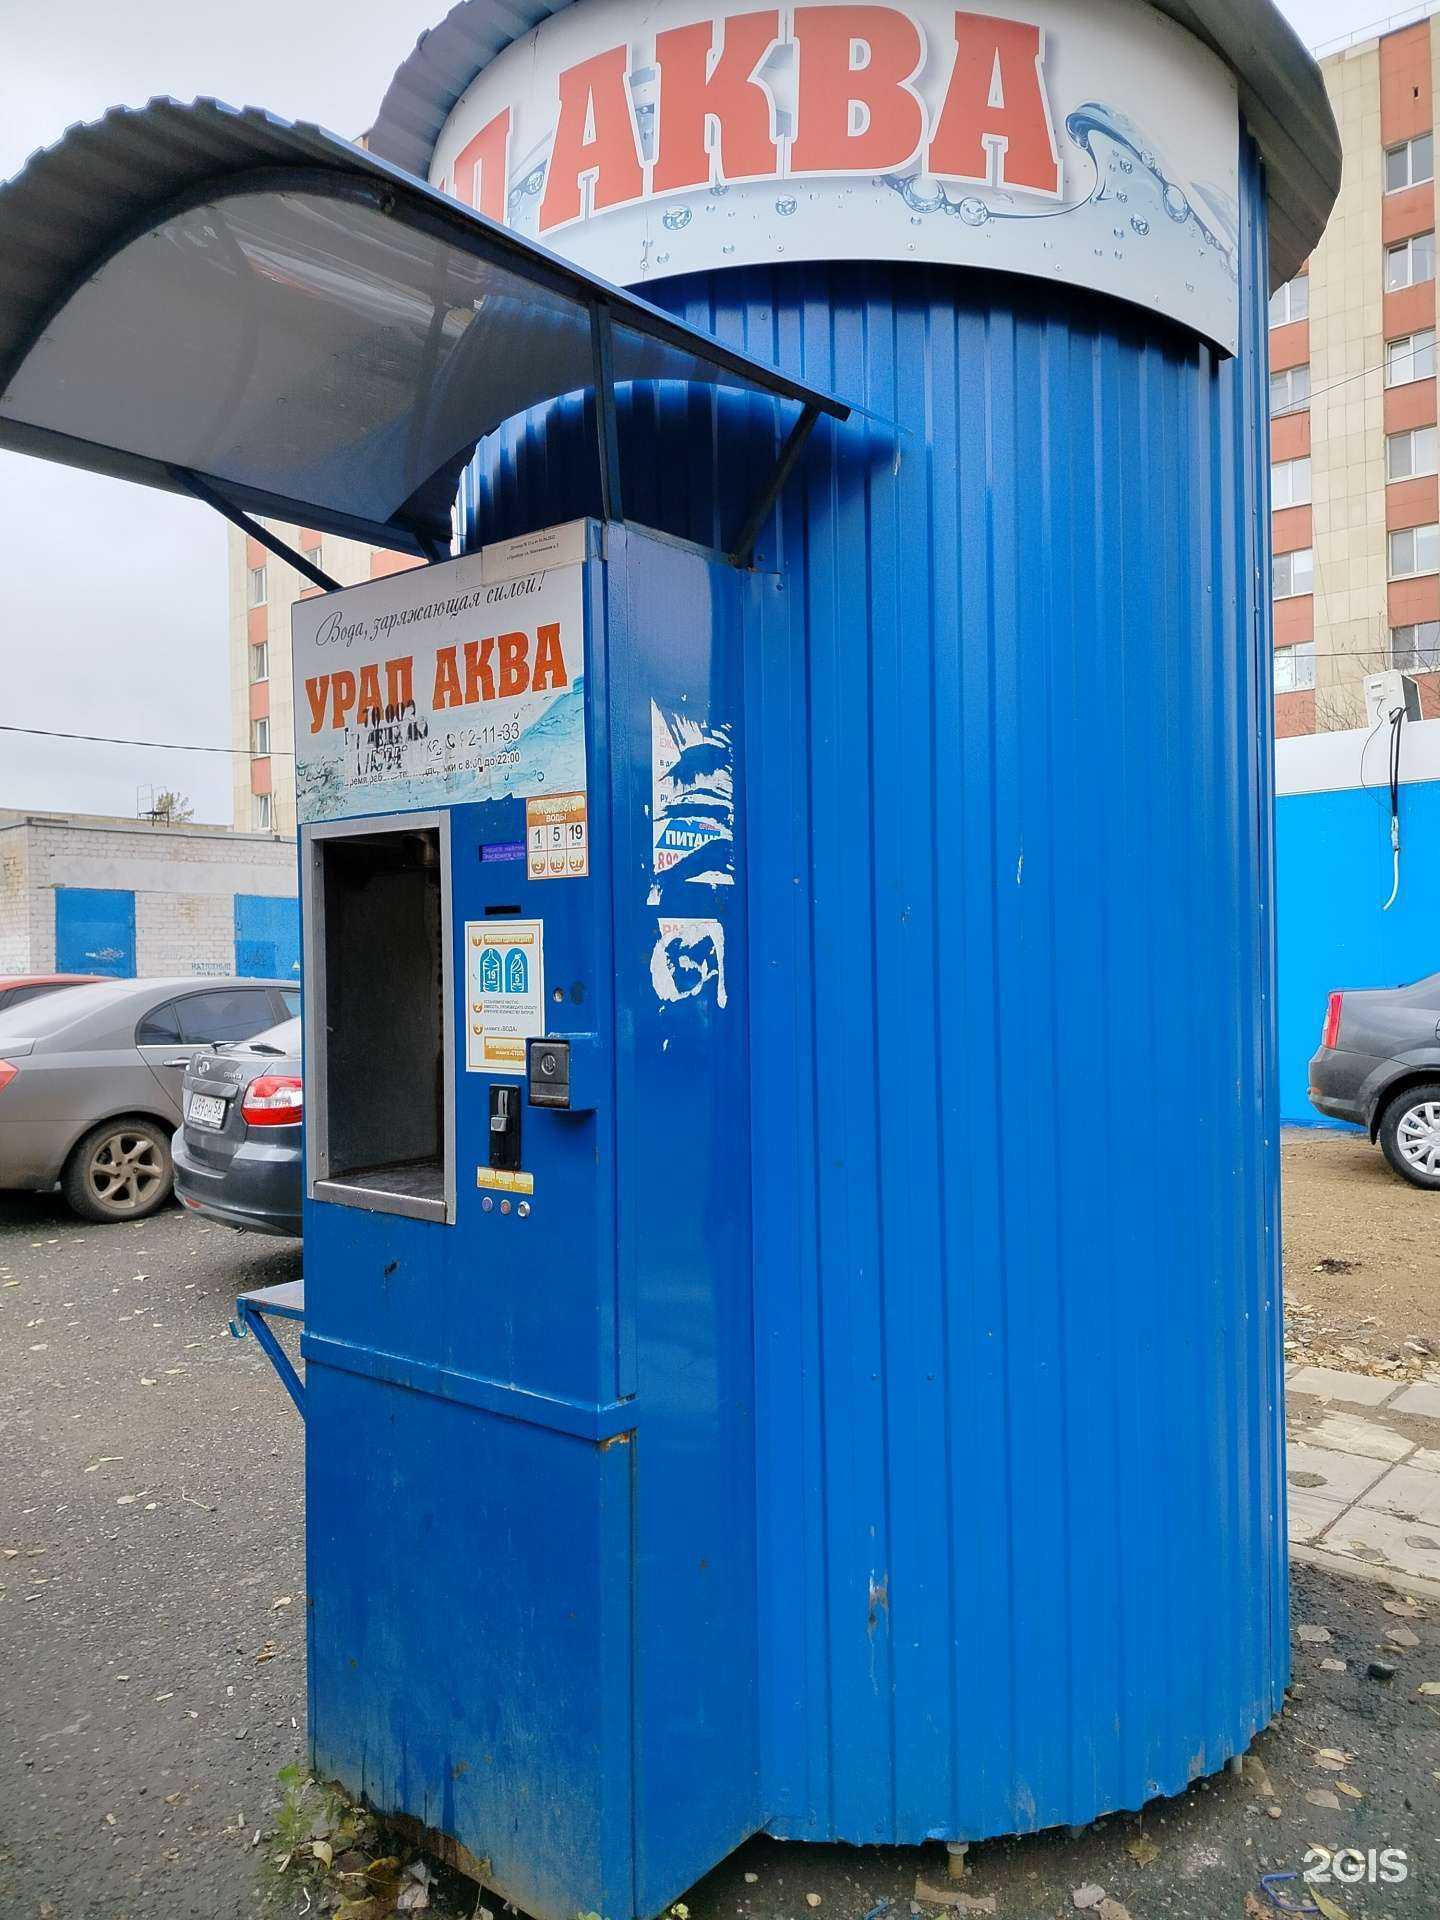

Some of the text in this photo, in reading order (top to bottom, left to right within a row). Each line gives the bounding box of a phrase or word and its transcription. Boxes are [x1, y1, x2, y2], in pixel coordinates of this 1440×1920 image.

[540, 5, 1060, 231] АКВА
[315, 611, 368, 647] Вода,
[370, 594, 480, 641] заряжающая
[432, 622, 568, 710] АКВА
[497, 752, 520, 764] 22:00
[534, 824, 583, 844] 1 5 19
[487, 970, 496, 980] 19
